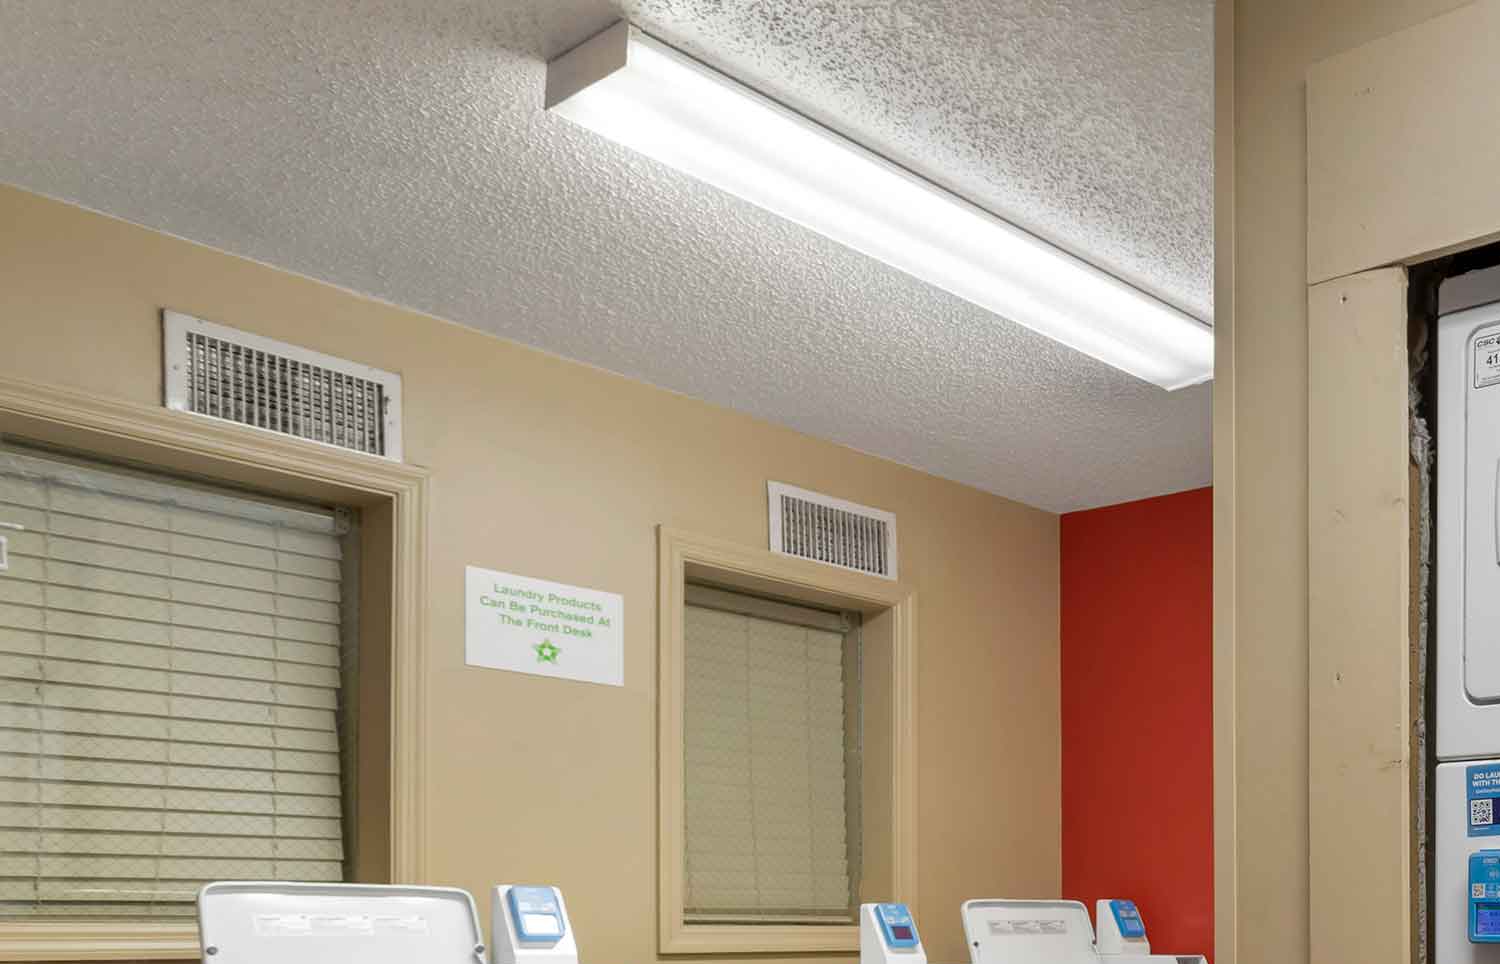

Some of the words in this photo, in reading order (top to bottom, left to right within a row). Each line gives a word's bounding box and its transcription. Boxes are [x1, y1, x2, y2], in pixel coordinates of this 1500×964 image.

[494, 584, 545, 603] Laundry
[548, 592, 602, 613] Products
[480, 595, 505, 609] Can
[510, 601, 526, 611] Be
[530, 604, 594, 624] Purchased
[598, 616, 611, 628] At
[499, 614, 523, 626] The
[528, 618, 560, 633] Front
[563, 625, 592, 638] Desk
[1472, 780, 1491, 788] WITH
[1473, 772, 1484, 781] DO
